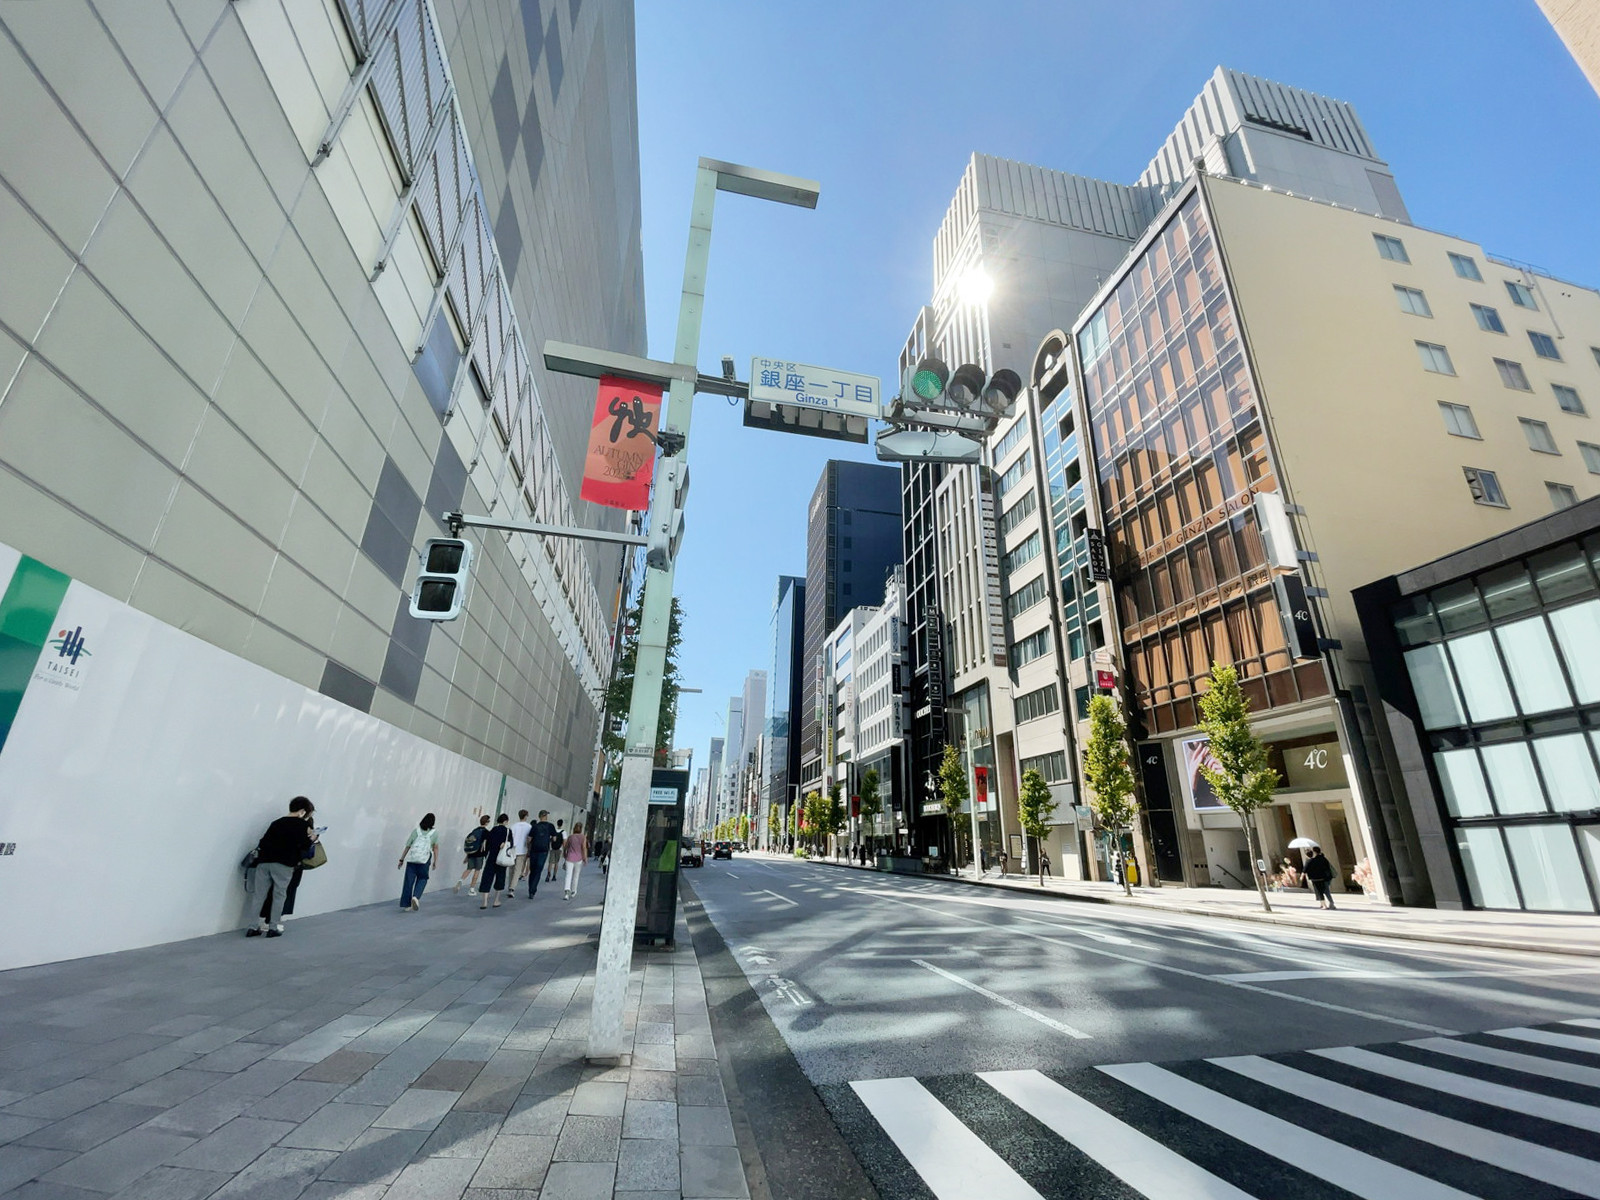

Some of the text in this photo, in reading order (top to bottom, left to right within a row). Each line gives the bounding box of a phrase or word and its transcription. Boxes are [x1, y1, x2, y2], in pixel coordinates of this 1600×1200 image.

[760, 359, 797, 373] 中央区
[760, 369, 873, 403] 銀座一丁目
[795, 392, 839, 408] Ginza 1
[593, 445, 643, 463] AUTUMN
[1176, 486, 1259, 544] GINZA SALON
[1090, 541, 1099, 573] SALON
[1096, 541, 1106, 573] GINZA
[47, 661, 80, 678] TAISEI
